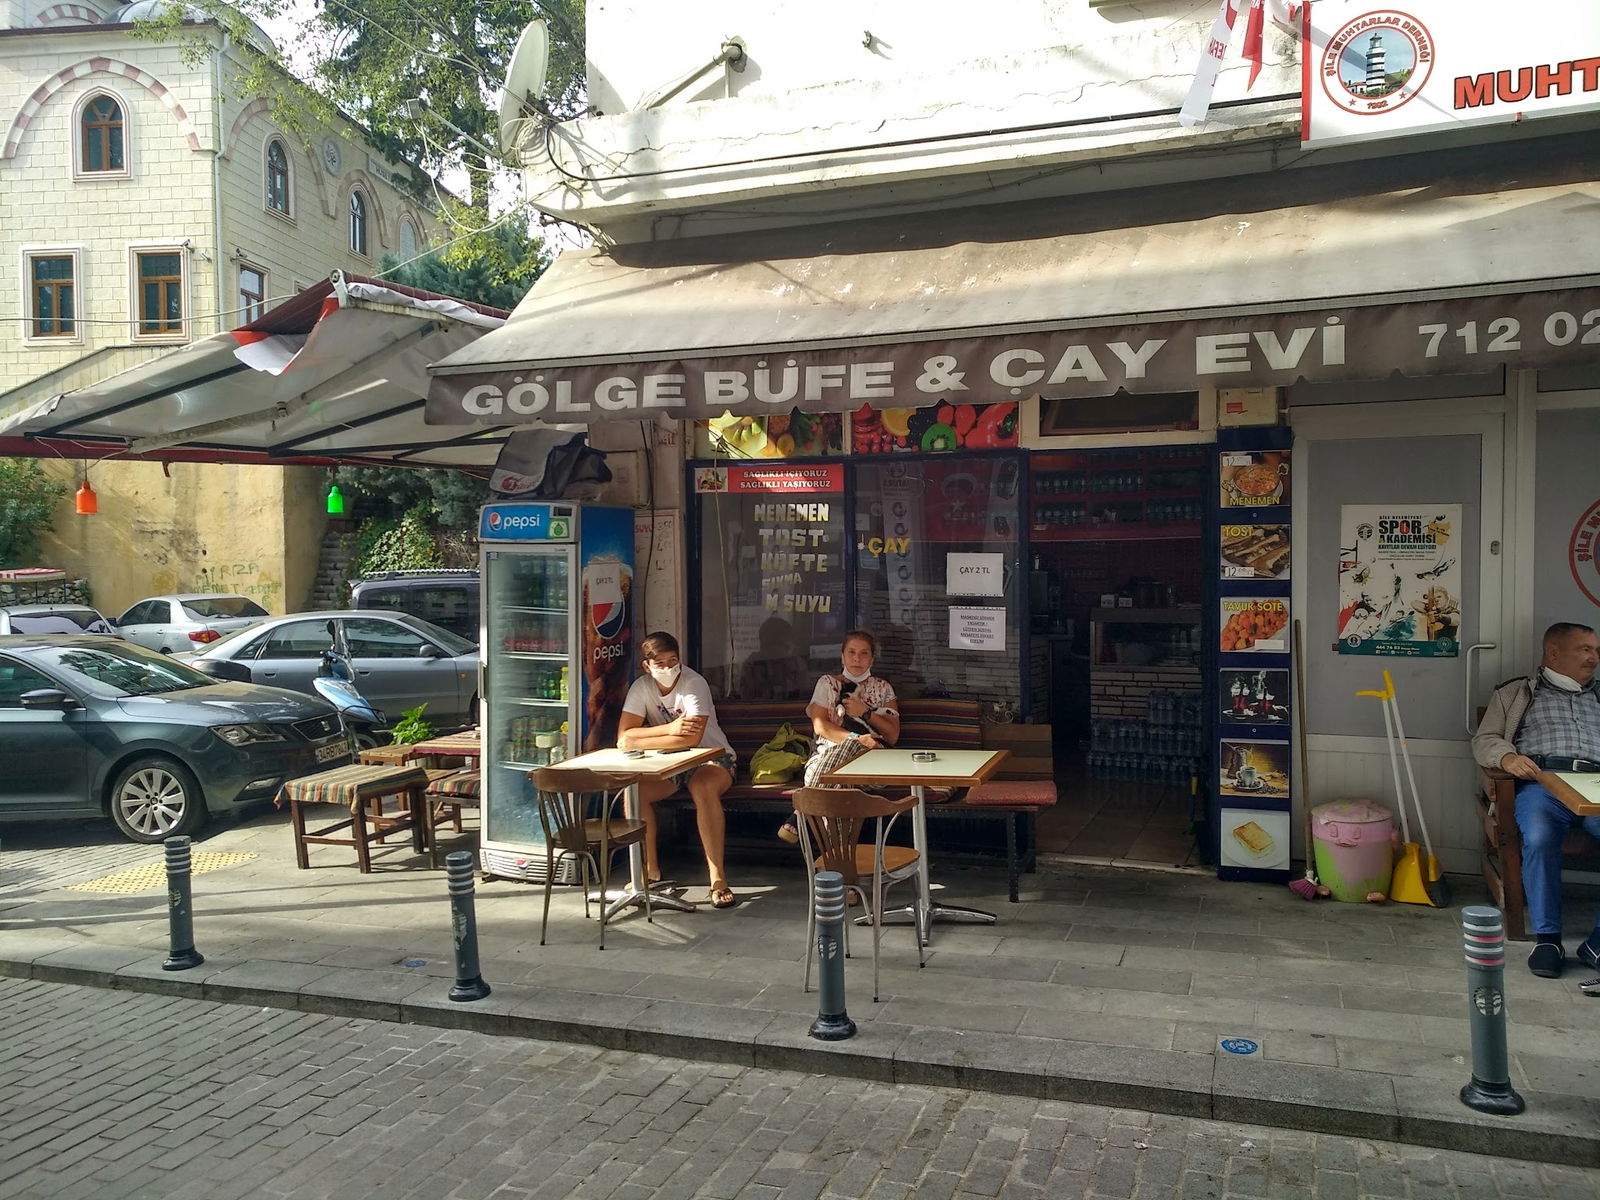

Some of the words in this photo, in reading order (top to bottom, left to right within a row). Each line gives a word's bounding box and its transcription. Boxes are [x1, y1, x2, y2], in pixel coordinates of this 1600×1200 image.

[1325, 52, 1337, 77] ŞİLE
[1333, 16, 1401, 51] MUHTARLAR
[1401, 20, 1430, 63] DERNEĞİ
[461, 373, 686, 416] GÖLGE
[704, 358, 895, 405] BÜFE
[915, 354, 970, 393] &
[989, 338, 1168, 396] ÇAY
[1196, 315, 1345, 376] EVİ
[1418, 317, 1521, 358] 712
[740, 480, 780, 489] SAĞLIKLI
[1230, 496, 1280, 506] MENEMEN
[503, 513, 541, 530] pepsi
[754, 503, 829, 522] MENEMEN
[1224, 526, 1254, 537] TOST
[1379, 520, 1422, 534] SPOR
[758, 528, 824, 547] TOST
[1378, 533, 1436, 543] AKADEMİSİ
[1575, 531, 1593, 561] ŞİLE
[867, 537, 912, 559] ÇAY
[960, 566, 974, 575] ÇAY
[975, 566, 981, 574] 2
[784, 594, 831, 613] SUYU
[1224, 602, 1254, 612] TAVUK
[1257, 602, 1284, 612] SOTE
[593, 640, 624, 664] pepsi
